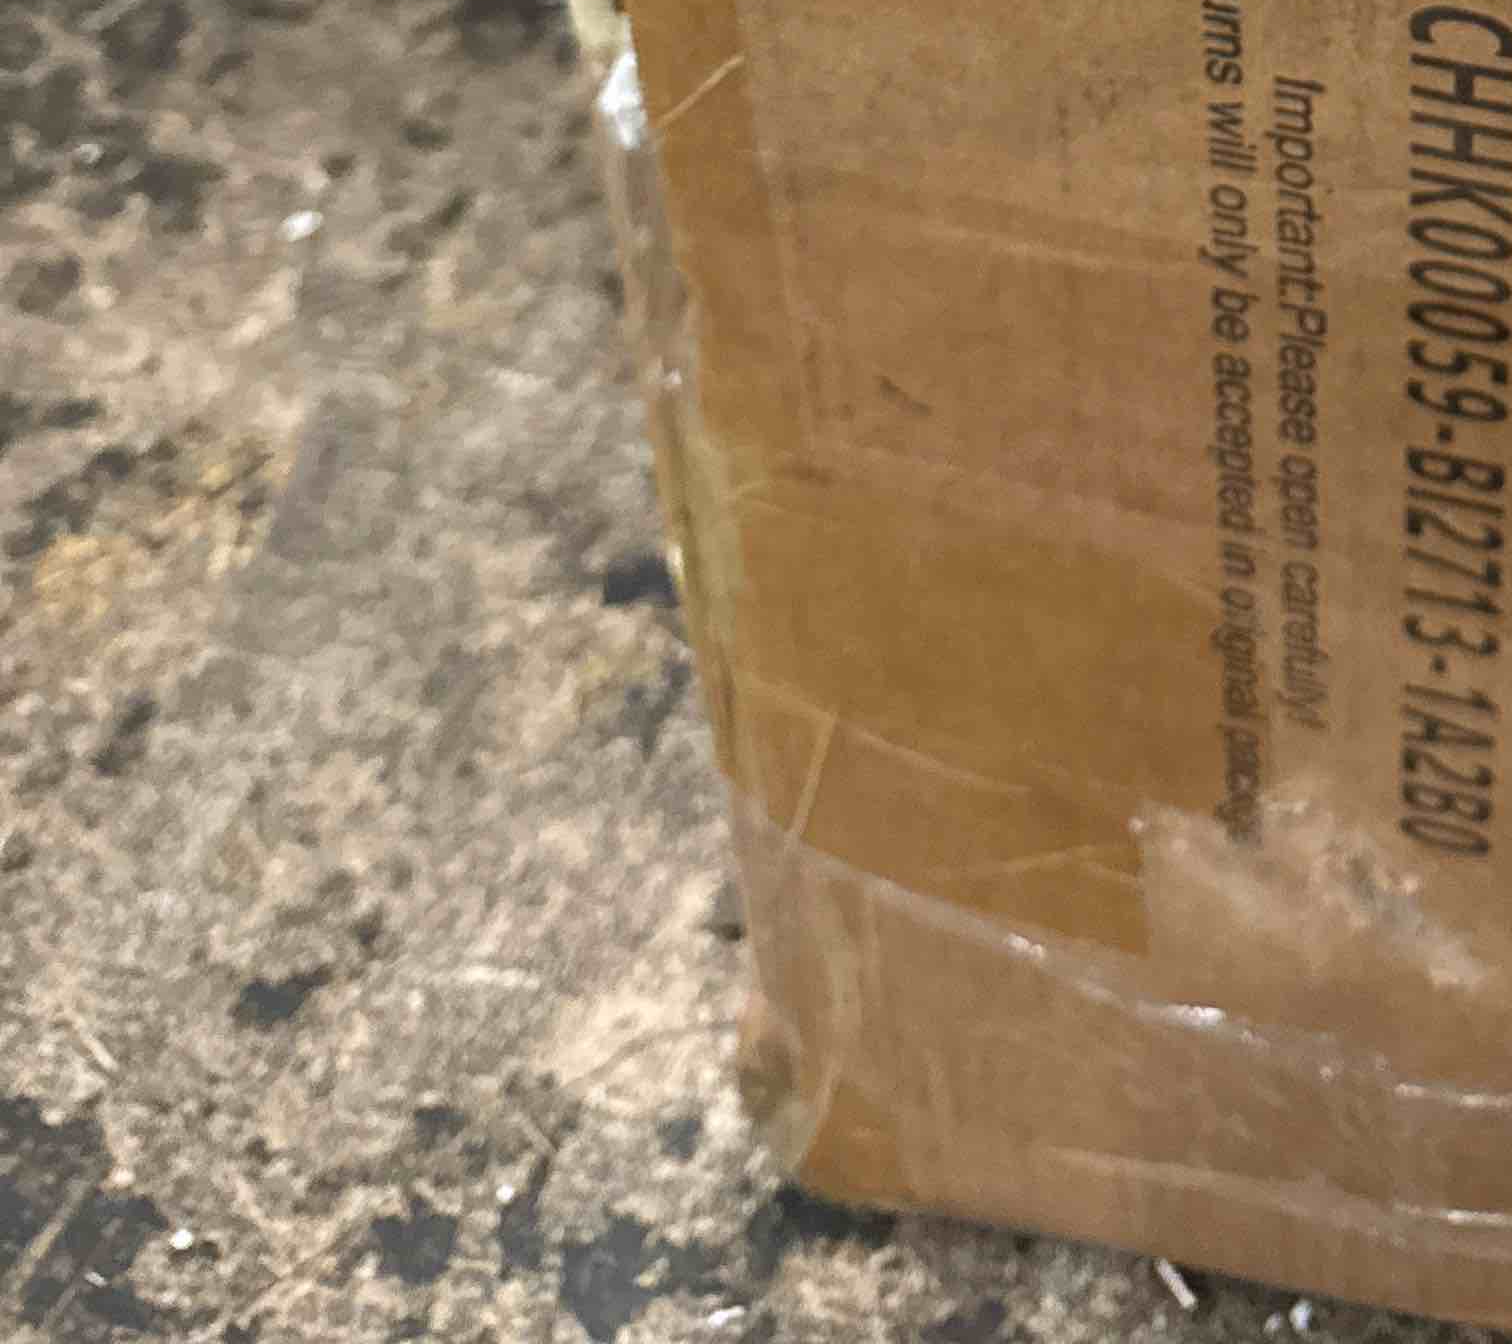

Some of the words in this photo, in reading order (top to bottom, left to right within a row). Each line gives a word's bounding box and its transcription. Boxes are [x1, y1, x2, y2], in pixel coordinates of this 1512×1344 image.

[1208, 101, 1257, 174] will
[1198, 185, 1259, 277] only
[1211, 288, 1261, 343] be
[1206, 353, 1266, 537] accepted
[1270, 454, 1319, 550] open
[1221, 539, 1266, 576] in
